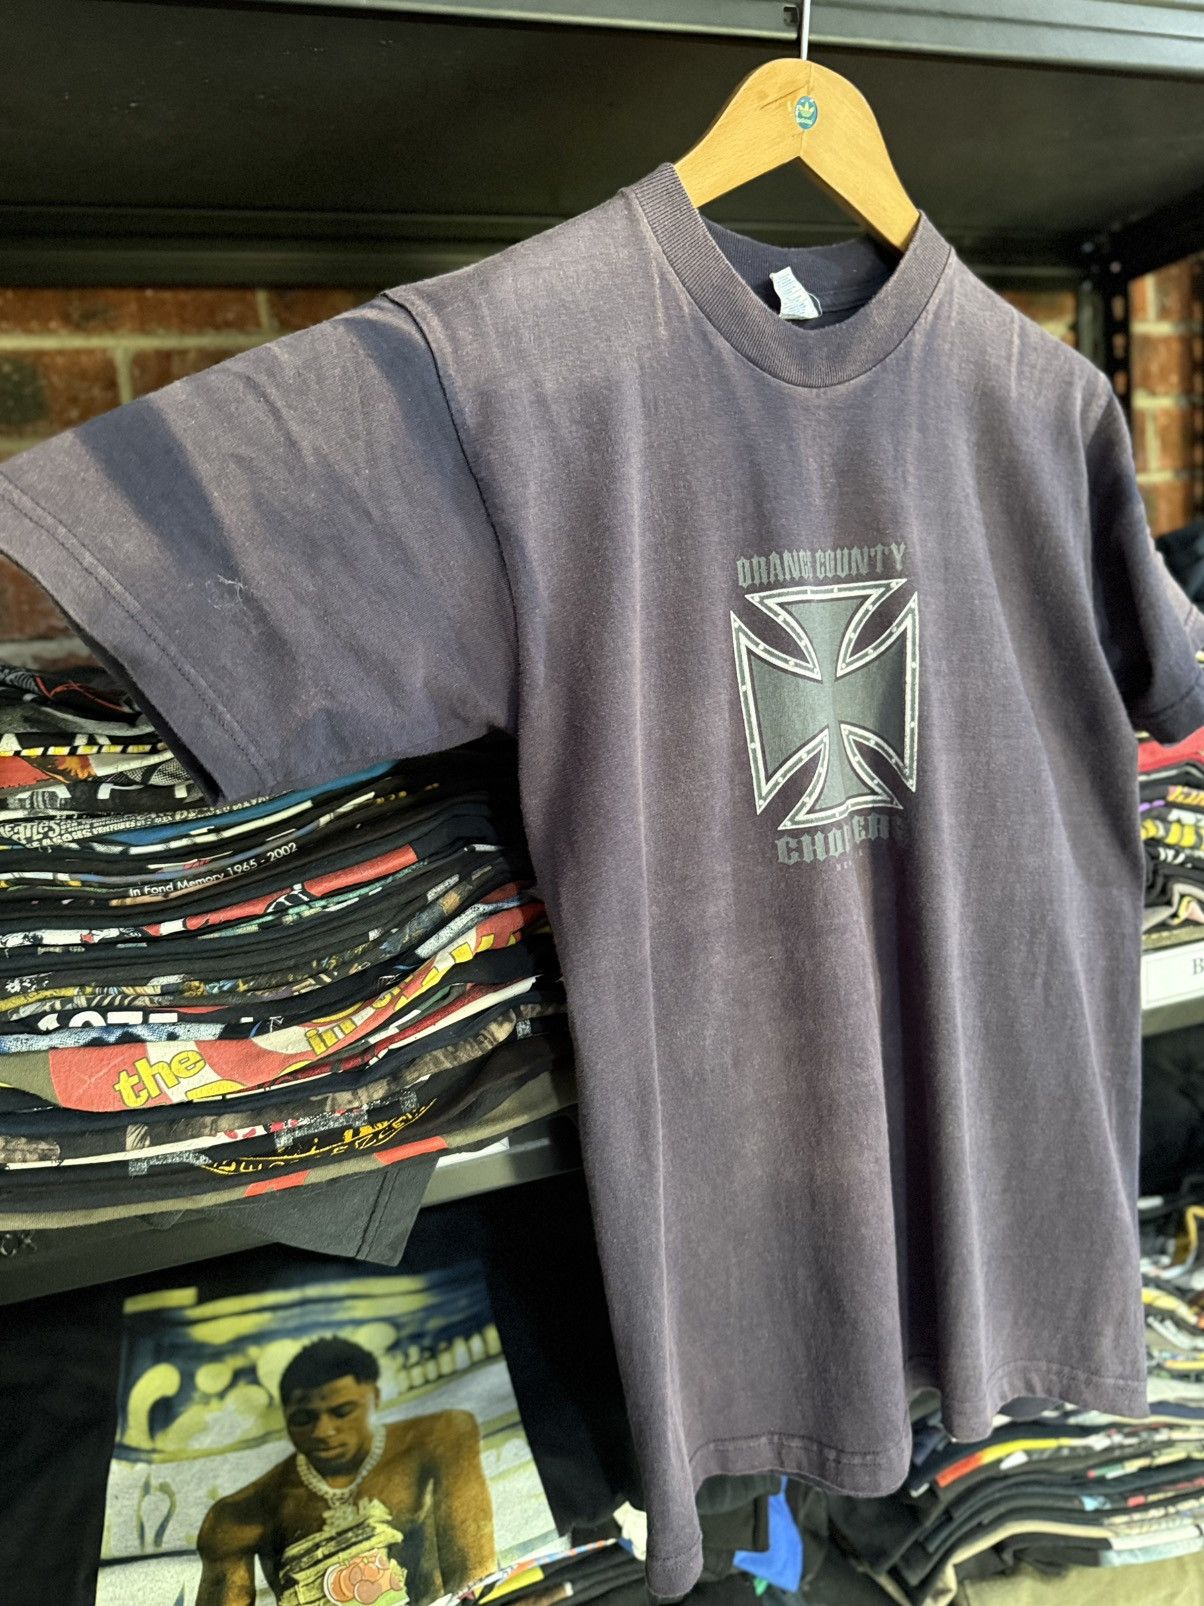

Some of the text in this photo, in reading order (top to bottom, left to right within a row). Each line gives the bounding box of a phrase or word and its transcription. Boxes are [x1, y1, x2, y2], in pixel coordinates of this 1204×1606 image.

[815, 542, 907, 580] COUNTY
[775, 812, 901, 866] CHOER
[129, 888, 142, 897] In
[144, 881, 174, 895] Fond
[177, 871, 225, 891] Memory
[227, 858, 258, 877] 1965
[266, 842, 299, 862] 2002
[113, 1049, 207, 1108] the
